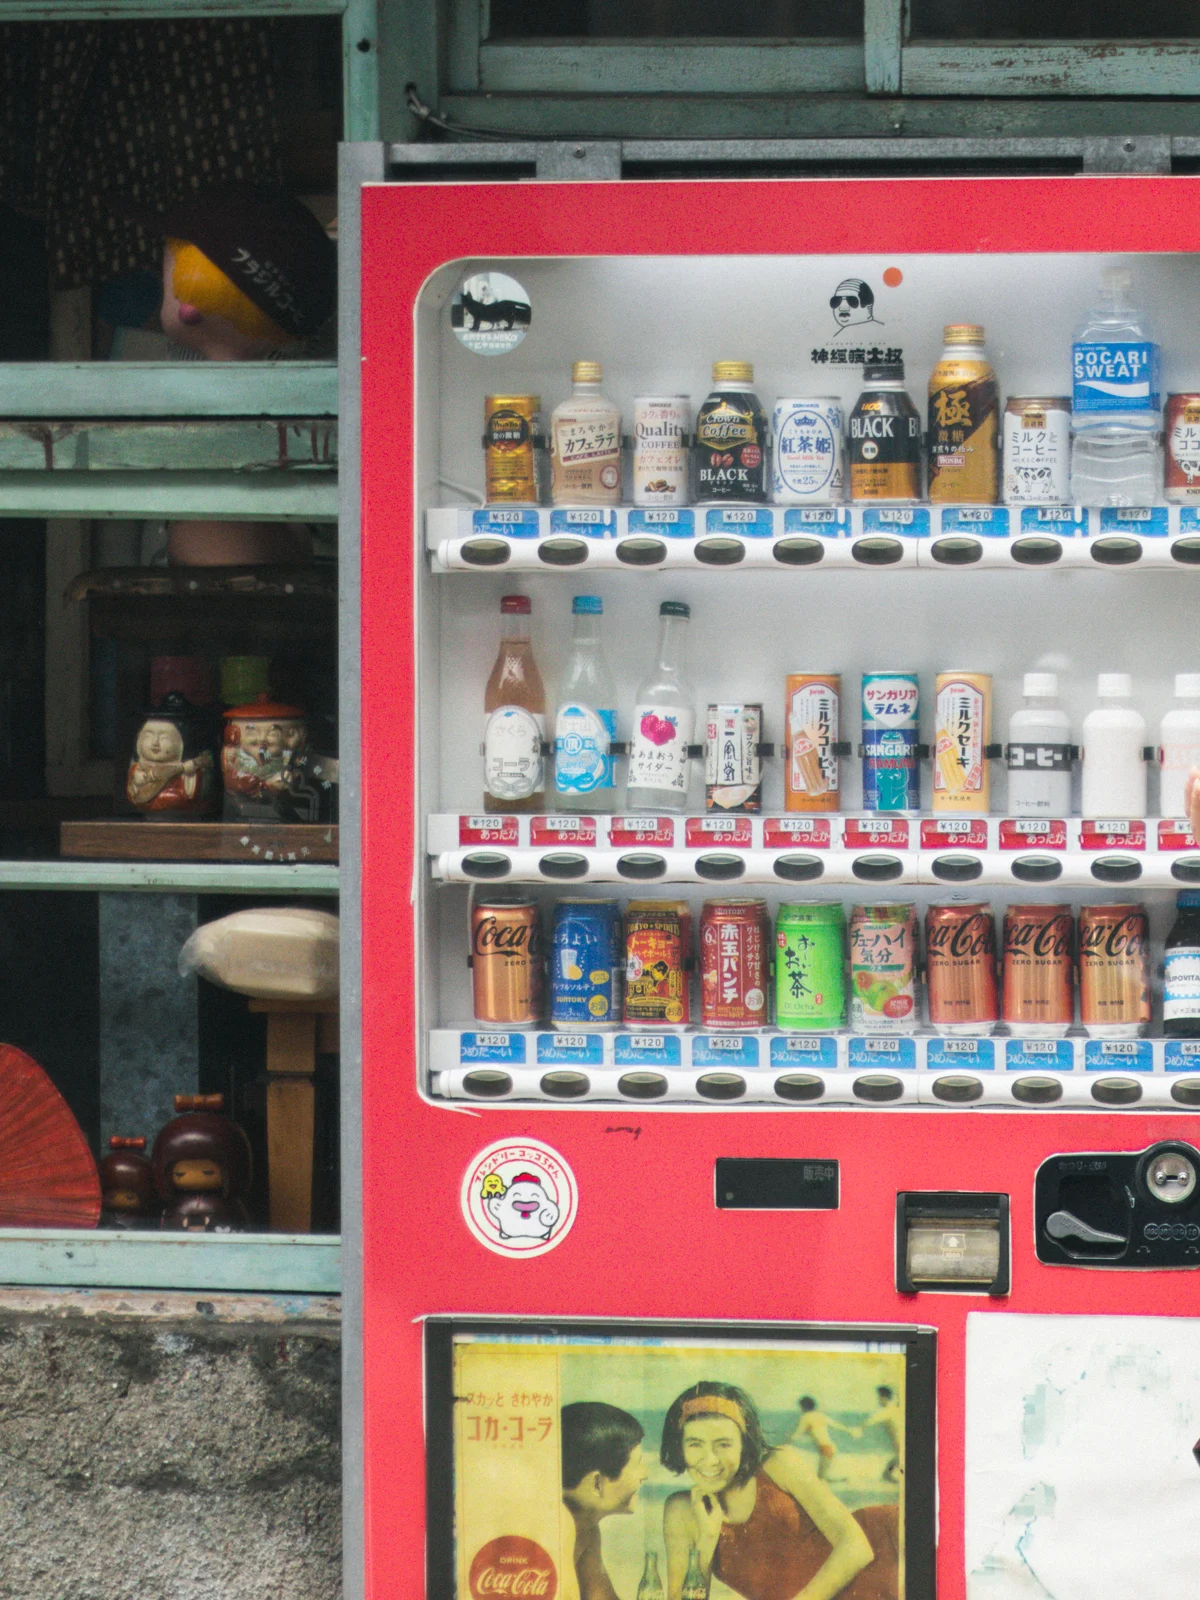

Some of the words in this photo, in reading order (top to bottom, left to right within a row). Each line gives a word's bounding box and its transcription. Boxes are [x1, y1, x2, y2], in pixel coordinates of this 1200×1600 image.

[1074, 351, 1148, 365] POCARI
[1074, 364, 1141, 379] SWEAT
[935, 391, 973, 427] 極
[706, 413, 740, 424] Crown
[570, 424, 606, 435] まろやか
[703, 423, 747, 442] Coffee
[851, 417, 894, 438] BLACK
[564, 432, 615, 454] カフェラテ
[1011, 431, 1058, 444] ミルクと
[641, 441, 681, 449] COFFEE
[1011, 445, 1058, 456] コーヒー
[640, 455, 681, 464] カフェオレ
[700, 468, 748, 481] BLACK
[493, 512, 519, 521] ¥120
[570, 512, 597, 521] ¥120
[648, 512, 675, 521] ¥120
[727, 512, 753, 521] ¥120
[866, 689, 917, 701] サンガリア
[873, 703, 911, 715] ラムネ
[956, 697, 972, 769] ミルクセーキ
[818, 698, 832, 780] ミルクコーヒー
[638, 751, 674, 761] あまおう
[723, 731, 743, 782] 一風堂
[1010, 747, 1063, 767] コーヒー
[492, 757, 530, 773] コーラ
[638, 763, 673, 771] サイダー
[472, 819, 499, 828] ¥120
[550, 820, 577, 829] ¥120
[627, 820, 655, 829] ¥120
[705, 821, 733, 830] ¥120
[783, 821, 811, 830] ¥120
[861, 822, 889, 831] ¥120
[940, 823, 968, 831] ¥120
[1019, 823, 1047, 831] ¥120
[1098, 823, 1126, 832] ¥120
[631, 936, 674, 949] トーキョー
[850, 927, 906, 949] チューハイ
[746, 926, 754, 978] ワインサワー
[753, 926, 762, 988] はじける甘さの
[860, 948, 894, 964] 気分
[720, 923, 740, 1004] 赤玉パンチ
[953, 959, 980, 967] SUGAR
[1108, 959, 1135, 967] SUGAR
[784, 946, 812, 999] お茶
[479, 1036, 506, 1045] ¥120
[556, 1037, 584, 1046] ¥120
[634, 1038, 661, 1047] ¥120
[711, 1039, 739, 1048] ¥120
[790, 1040, 817, 1049] ¥120
[868, 1041, 896, 1050] ¥120
[946, 1042, 974, 1051] ¥120
[1026, 1042, 1054, 1052] ¥120
[1105, 1043, 1133, 1053] ¥120
[475, 1151, 516, 1183] フレンドリー
[804, 1164, 834, 1181] 販売中
[467, 1391, 504, 1408] スカッと
[512, 1391, 553, 1408] さわやか
[467, 1415, 553, 1442] コカ・コーラ
[499, 1556, 528, 1565] DRINK
[476, 1566, 550, 1596] Coca-Cola
